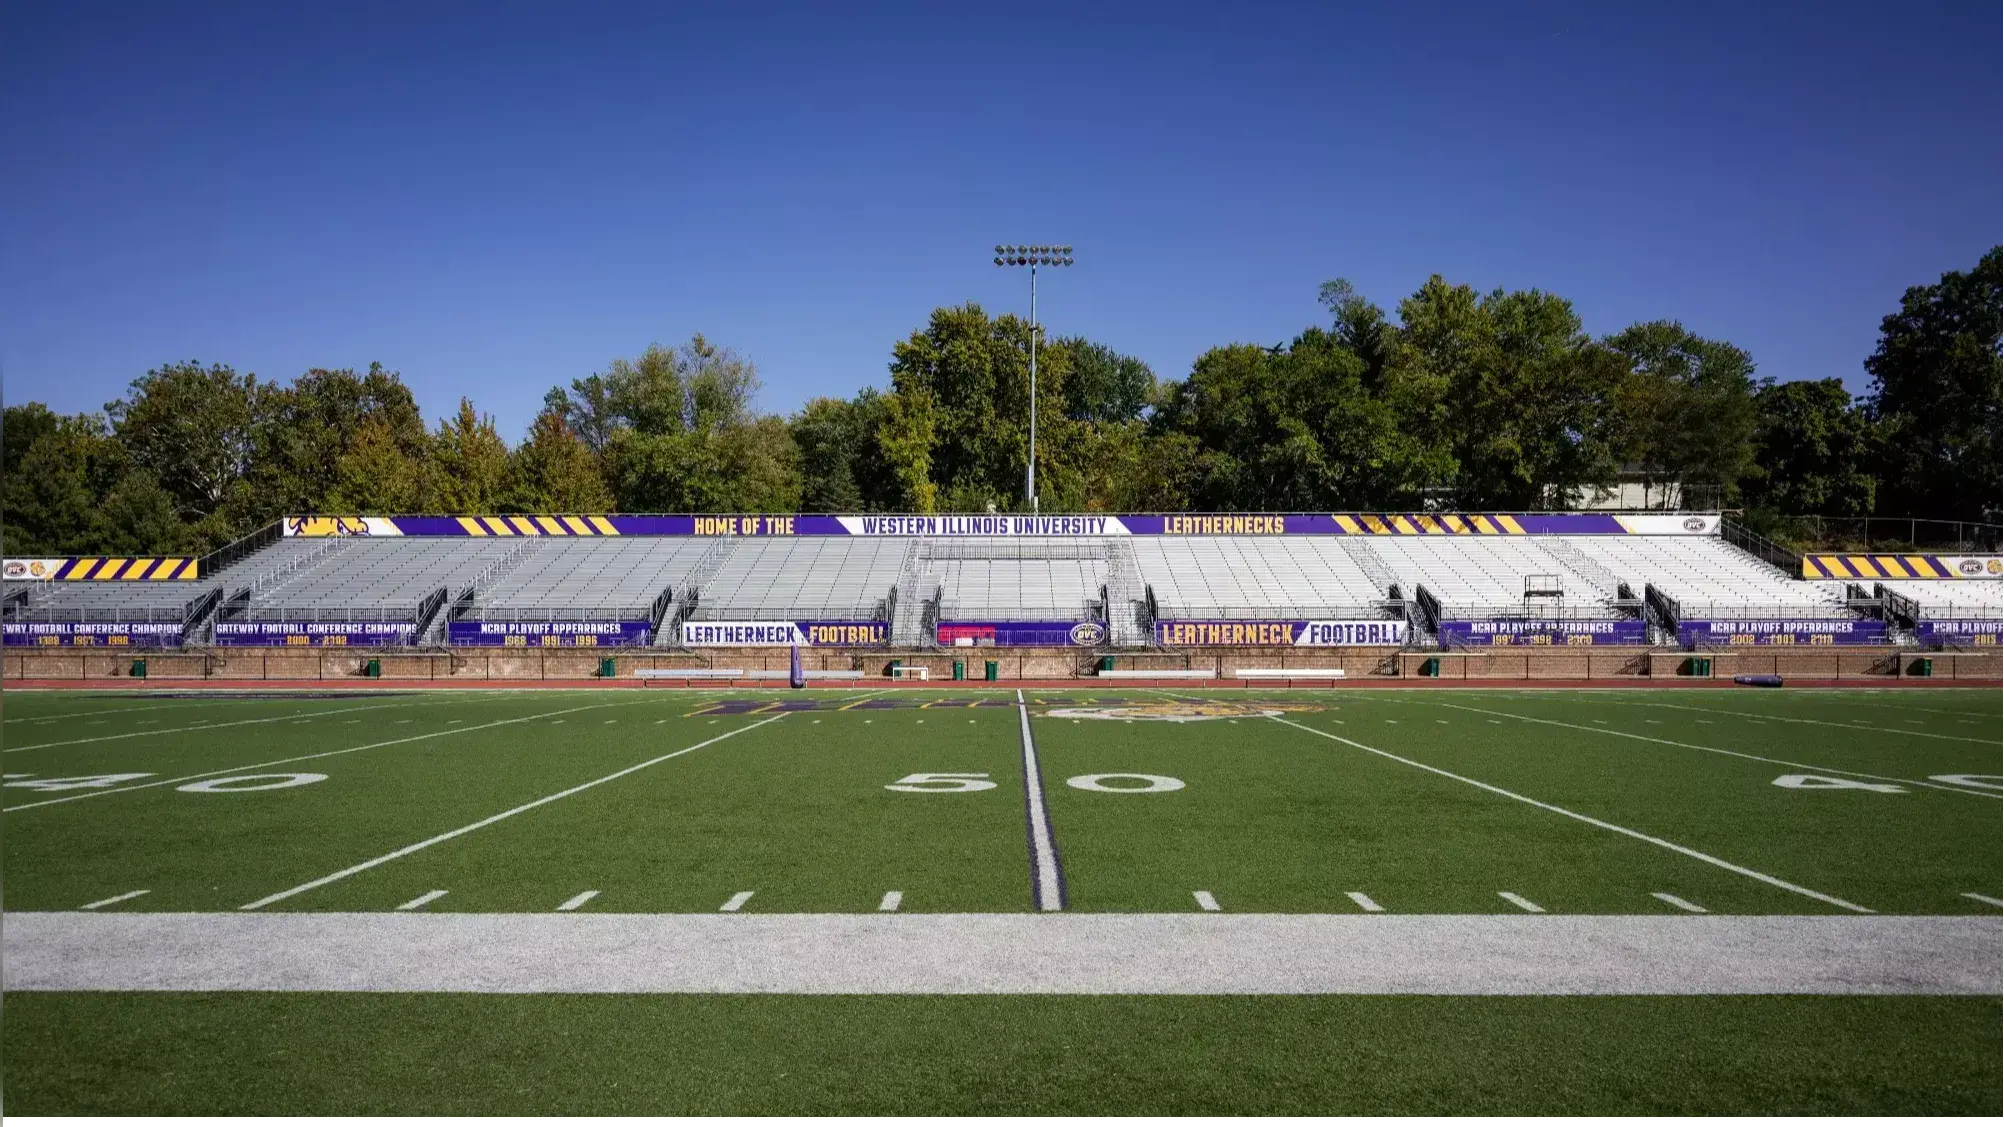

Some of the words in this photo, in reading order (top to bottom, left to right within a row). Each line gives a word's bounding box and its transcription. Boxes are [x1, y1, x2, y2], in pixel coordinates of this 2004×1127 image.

[694, 517, 737, 535] HOME
[742, 517, 760, 535] OF
[766, 517, 794, 535] THE
[862, 517, 936, 535] WESTERN
[942, 517, 1008, 534] ILLINOIS
[1013, 517, 1106, 534] UNIVERSITY
[1164, 516, 1284, 534] LEATHERNECKS
[29, 624, 72, 634] FOOTBALL
[74, 624, 130, 634] CONFERENCE
[132, 624, 183, 634] CHAMPIONS
[216, 623, 260, 634] GATEWAY
[262, 623, 305, 634] FOOTBALL
[307, 623, 363, 634] CONFERENCE
[365, 623, 417, 634] CHAMPIONS
[481, 623, 507, 634] NCAA
[509, 623, 550, 634] PLAYOFF
[552, 623, 621, 634] APPEARANCES
[1471, 622, 1497, 634] NCAA
[1710, 622, 1736, 633] NCAA
[1738, 622, 1781, 633] PLAYOFF
[1783, 622, 1853, 633] APPEARANCES
[1933, 622, 1959, 633] NCAA
[1962, 622, 2004, 633] PLAYOFF
[686, 625, 795, 643] LEATHERNECK
[810, 625, 884, 643] FOOTBALL
[1163, 624, 1293, 644] LEATHERNECK
[1310, 624, 1401, 644] FOOTBALL
[884, 773, 1186, 793] 50
